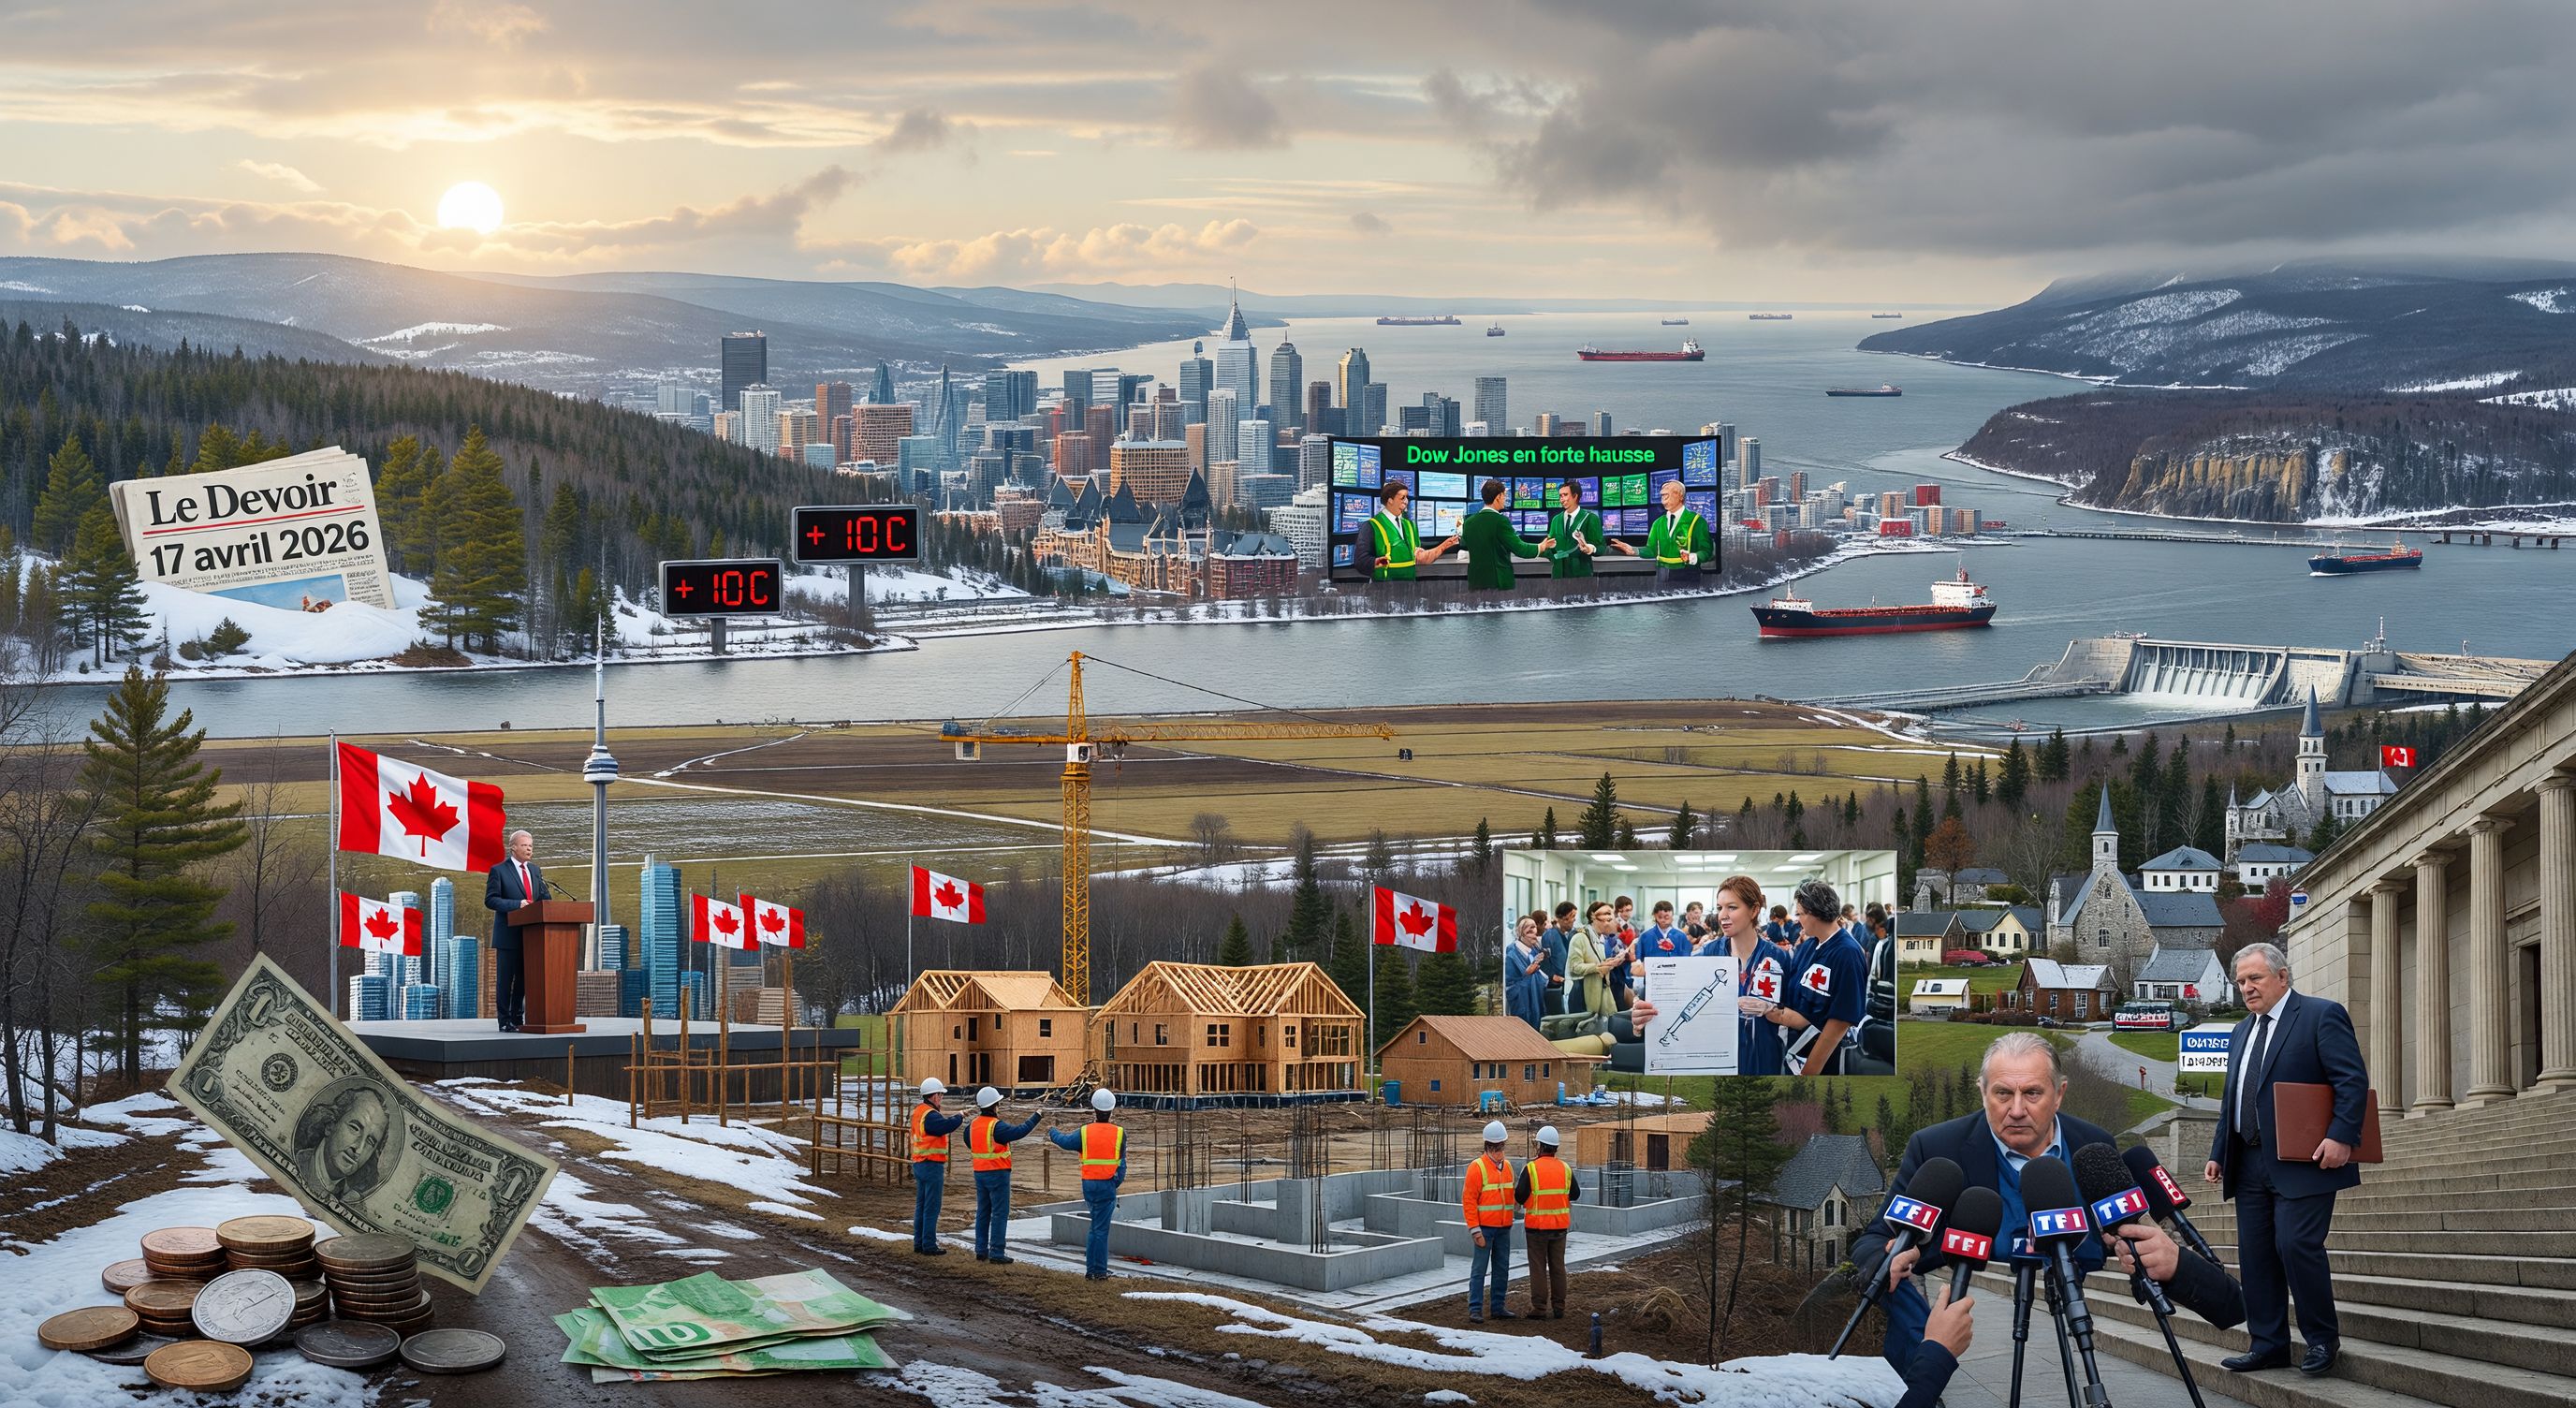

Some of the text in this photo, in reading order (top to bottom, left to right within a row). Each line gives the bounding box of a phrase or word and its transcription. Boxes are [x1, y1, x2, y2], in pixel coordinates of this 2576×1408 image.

[1407, 445, 1656, 464] Dow Jones en forte hausse
[146, 490, 198, 525] Le
[203, 473, 337, 520] Devoir
[150, 543, 184, 577] 17
[194, 531, 272, 572] avril
[279, 520, 370, 561] 2026
